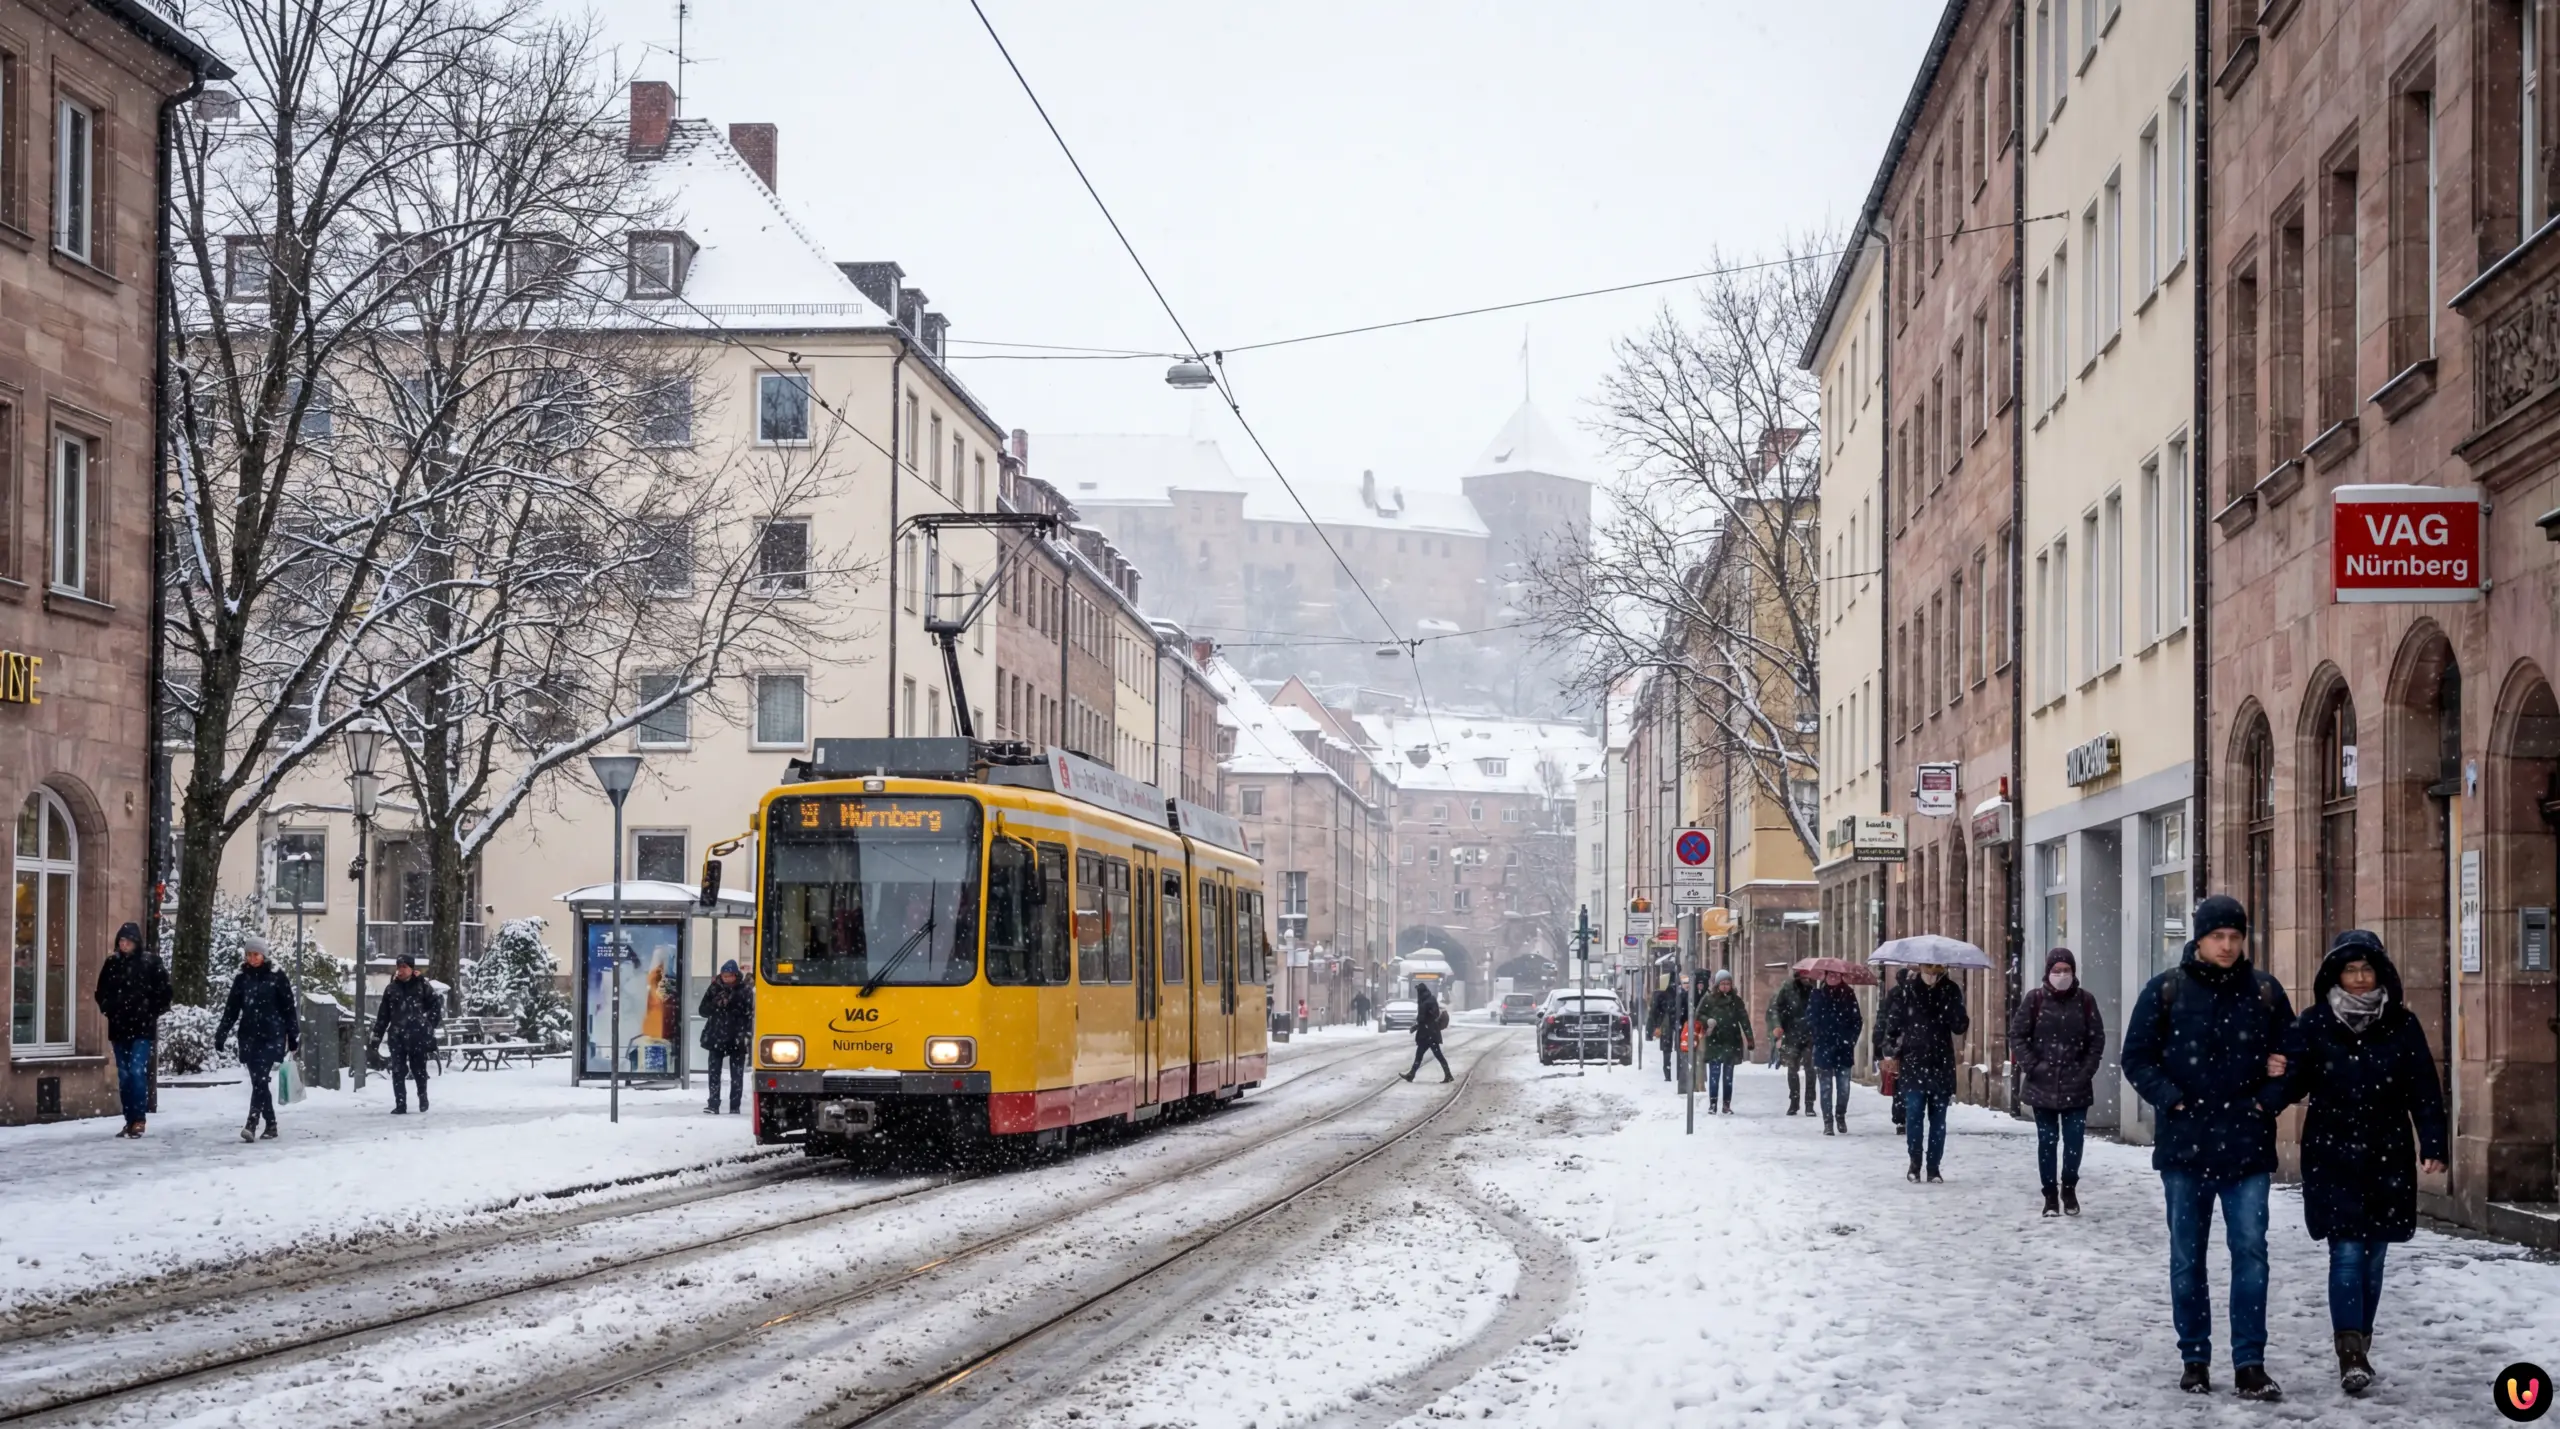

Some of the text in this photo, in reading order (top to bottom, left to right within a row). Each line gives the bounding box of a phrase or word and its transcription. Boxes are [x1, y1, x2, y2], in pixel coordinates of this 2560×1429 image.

[2364, 513, 2449, 547] VAG
[2345, 554, 2468, 582] Nürnberg
[839, 802, 942, 832] Nürnberg
[845, 1008, 879, 1021] VAG
[832, 1039, 893, 1055] Nürnberg
